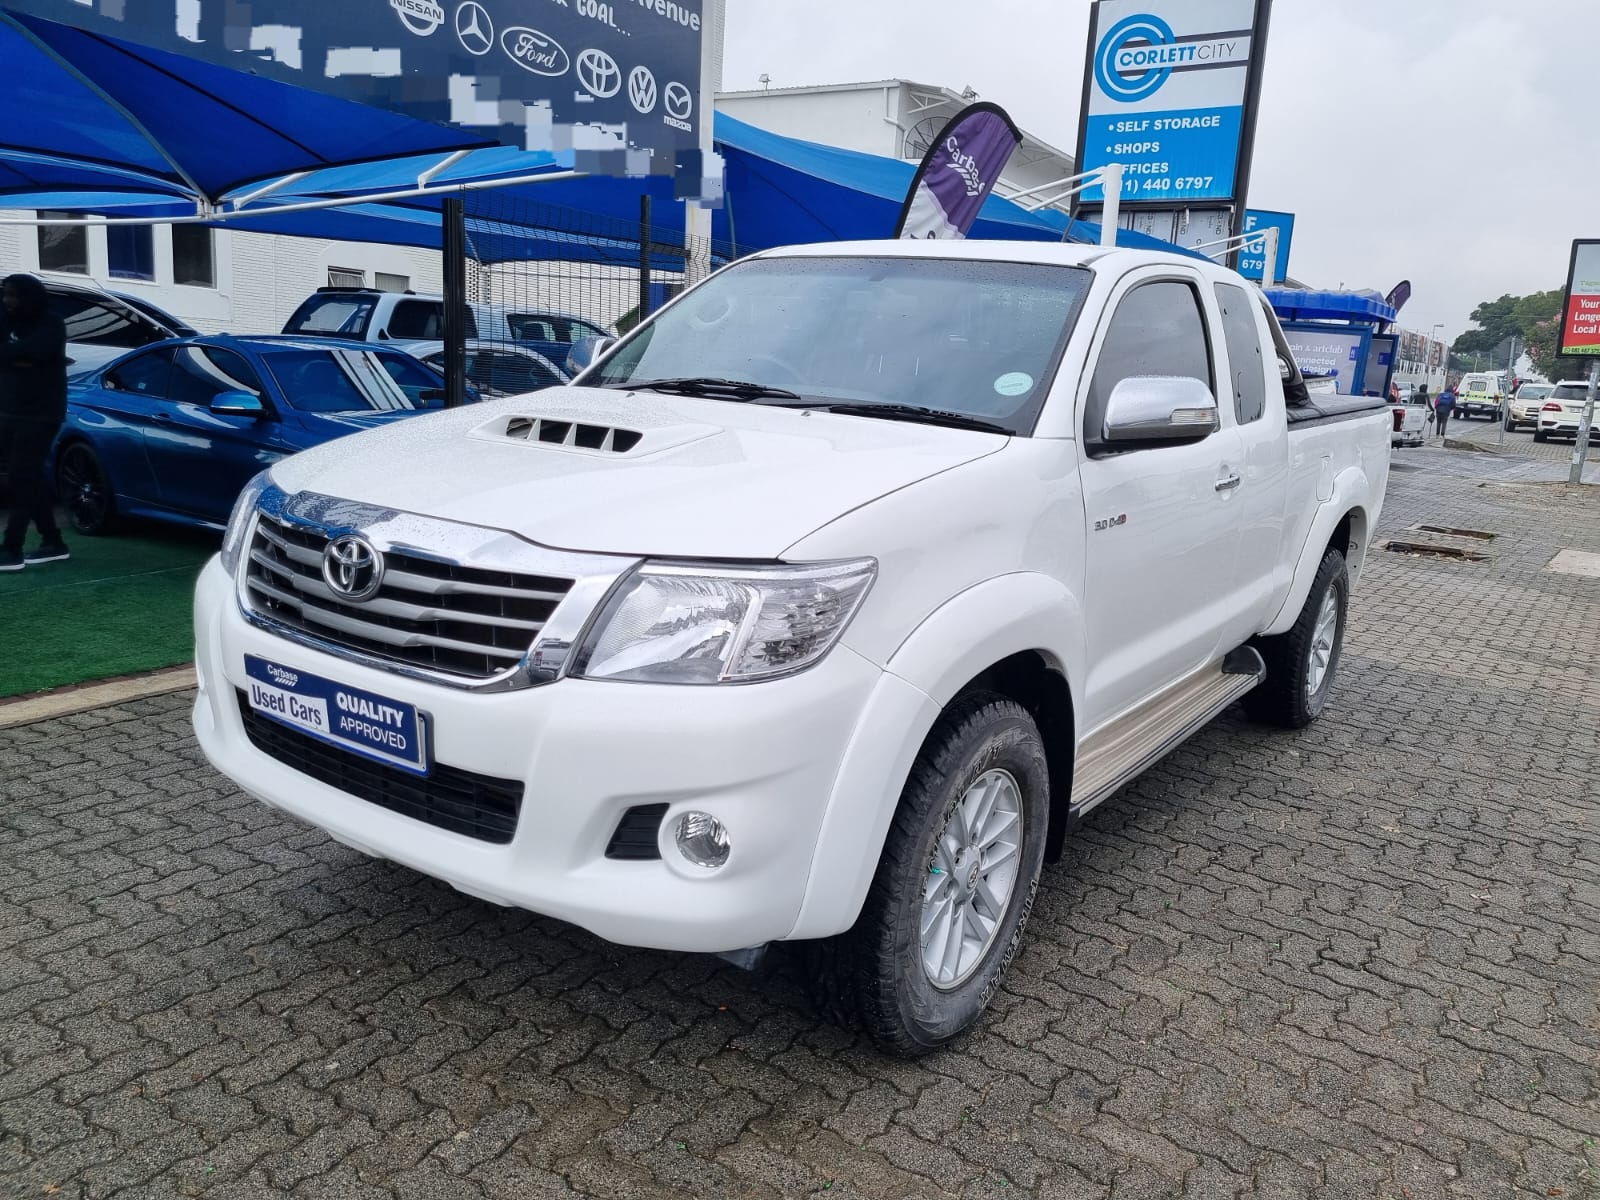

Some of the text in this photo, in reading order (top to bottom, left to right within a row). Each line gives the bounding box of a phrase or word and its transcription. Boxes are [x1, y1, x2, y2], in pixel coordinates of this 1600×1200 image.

[393, 0, 441, 20] NISSAN
[631, 0, 701, 31] venue
[514, 33, 558, 69] Ford
[1115, 115, 1221, 133] SELF STORAGE
[1113, 141, 1160, 155] SHOPS
[1120, 162, 1169, 175] FFICES
[1142, 177, 1171, 191] 440
[1174, 176, 1213, 190] 6797
[1242, 259, 1266, 270] 679
[1573, 324, 1597, 334] Local
[1295, 356, 1336, 366] onnected
[267, 664, 299, 683] Carbase
[251, 683, 323, 726] Used Cars
[335, 691, 405, 728] QUALITY
[339, 715, 407, 750] APPROVED
